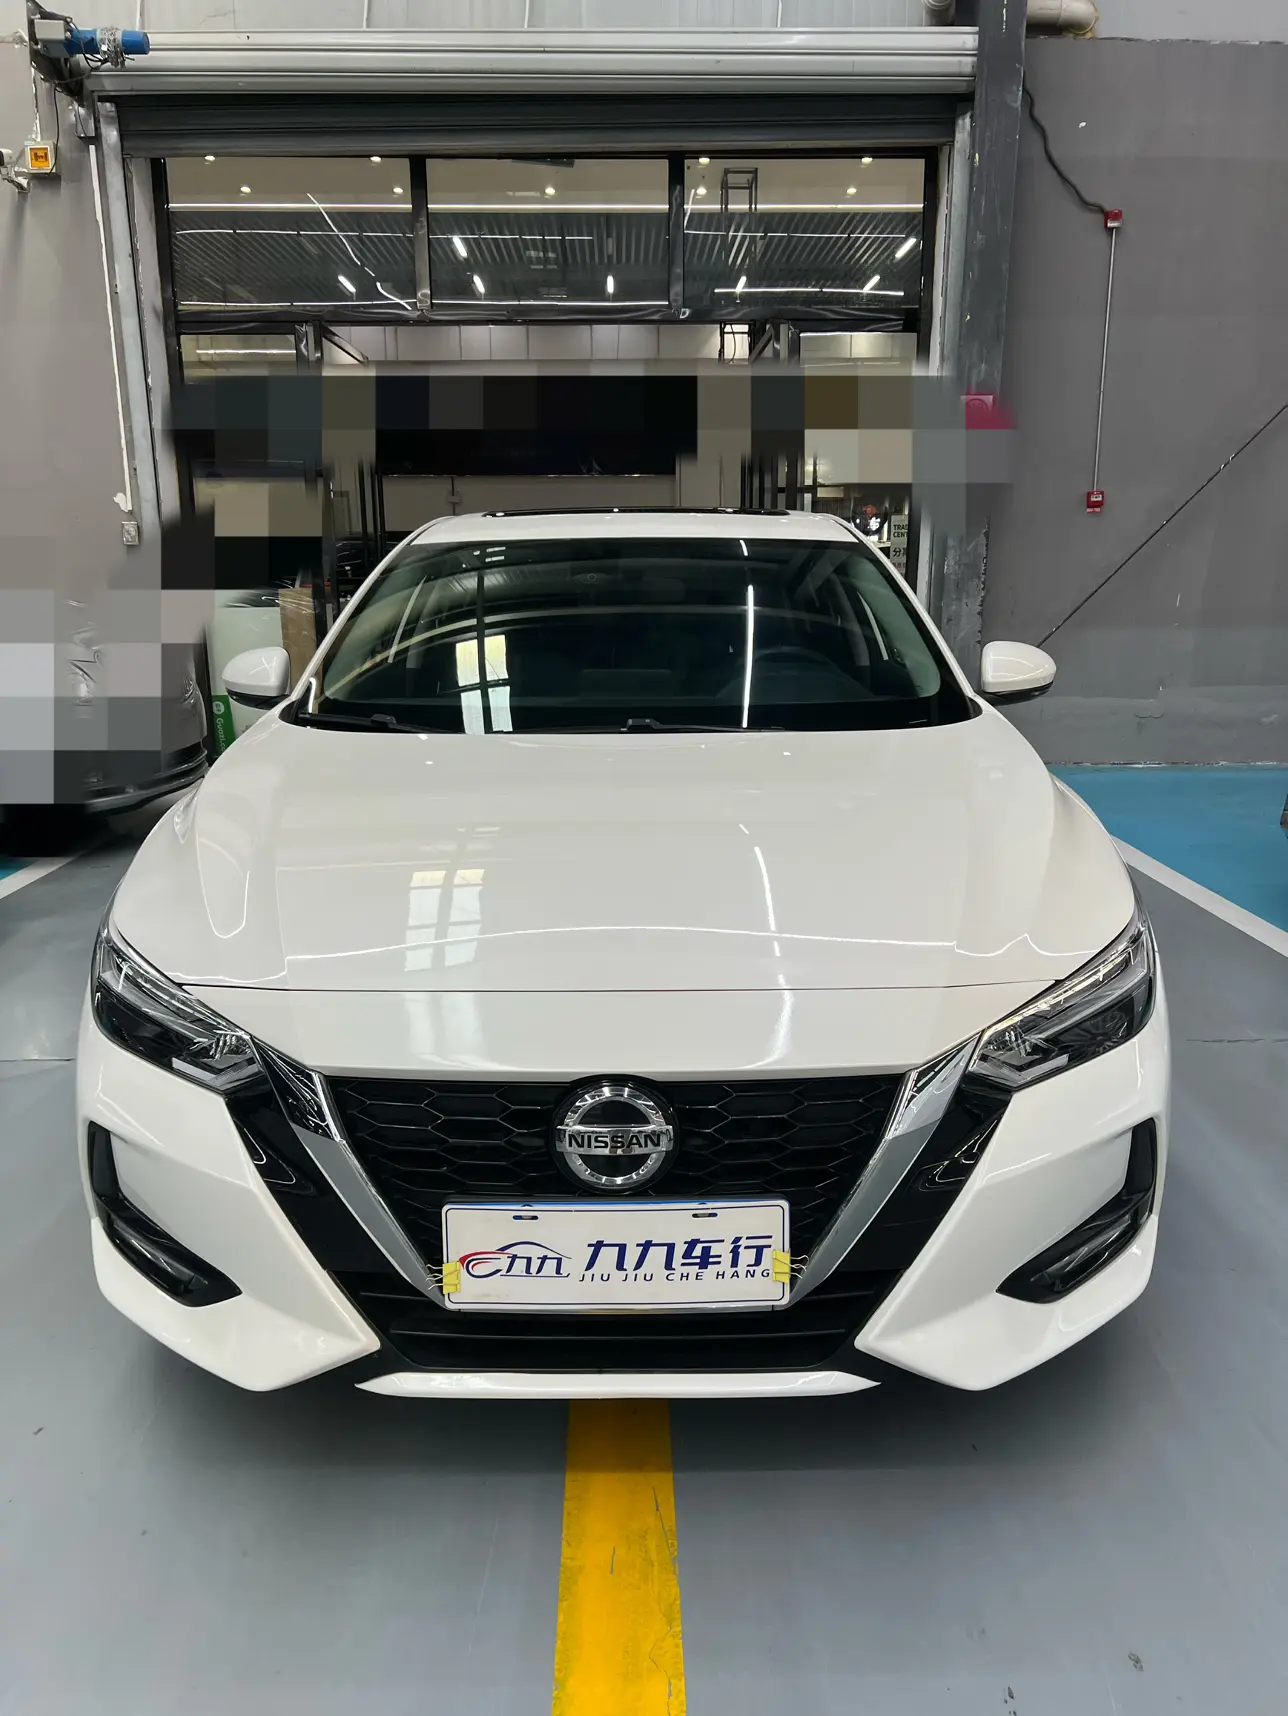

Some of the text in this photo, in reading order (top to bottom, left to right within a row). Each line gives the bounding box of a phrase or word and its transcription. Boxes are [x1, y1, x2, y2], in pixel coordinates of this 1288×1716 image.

[568, 1133, 660, 1149] NISSAN
[585, 1235, 772, 1271] 九九车行
[579, 1269, 771, 1282] JIU JIU CHE HANG
